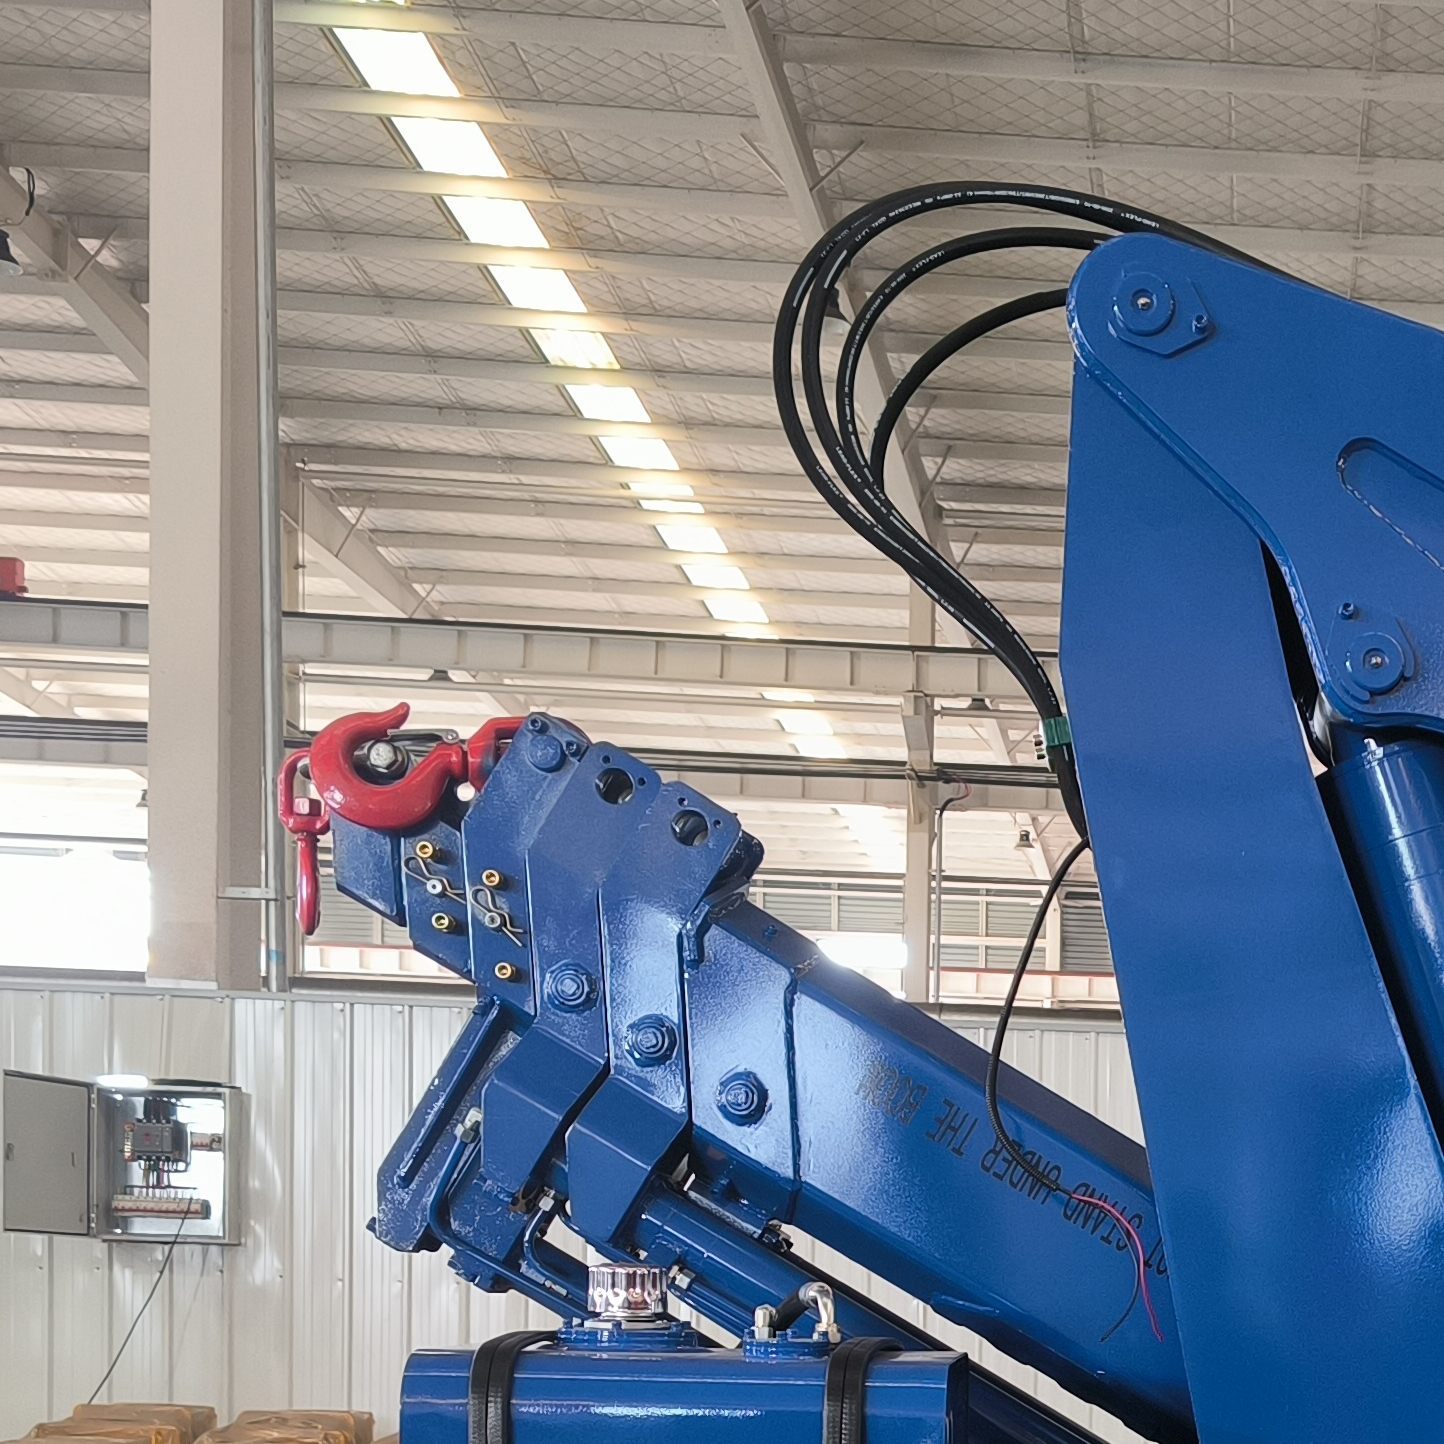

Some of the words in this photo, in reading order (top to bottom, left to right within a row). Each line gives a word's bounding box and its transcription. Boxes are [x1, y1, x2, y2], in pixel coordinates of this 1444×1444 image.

[925, 1098, 979, 1157] THE
[980, 1139, 1062, 1205] UNDER
[1062, 1182, 1144, 1252] STAND
